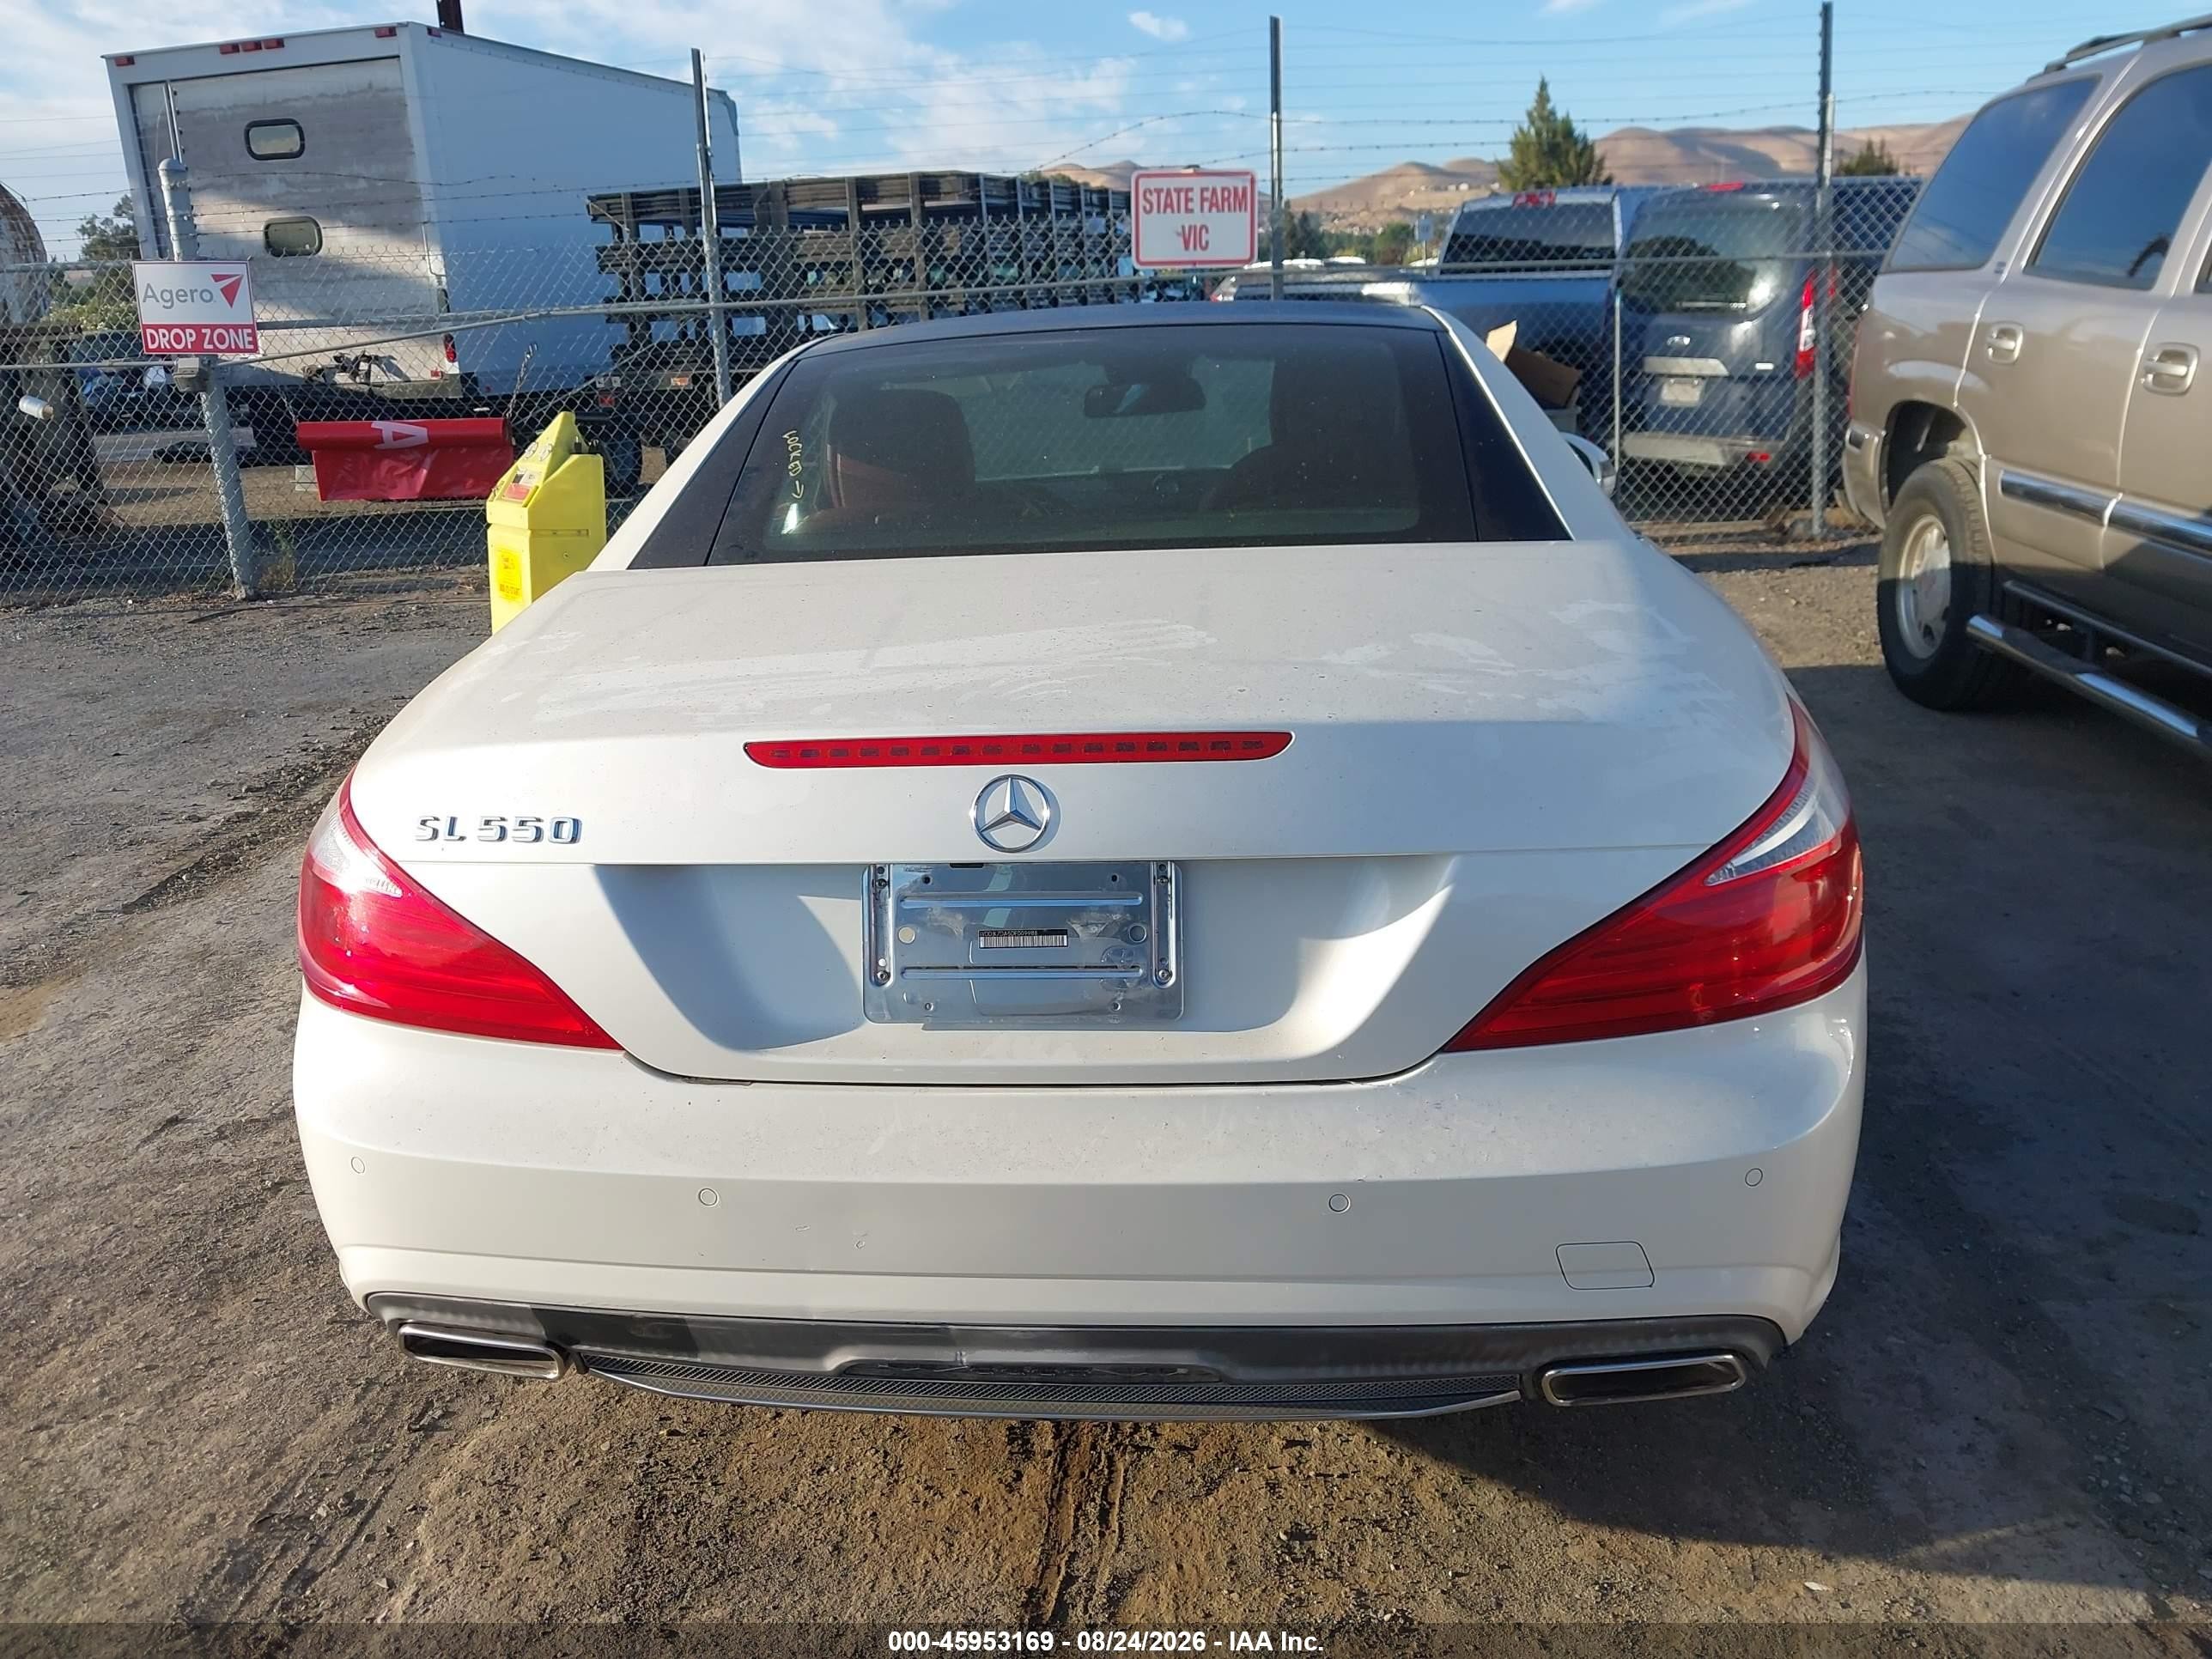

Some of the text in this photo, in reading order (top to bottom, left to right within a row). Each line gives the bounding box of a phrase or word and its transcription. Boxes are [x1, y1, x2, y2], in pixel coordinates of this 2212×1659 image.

[1142, 185, 1249, 215] STATE FARM
[1181, 223, 1210, 252] VIC
[142, 283, 214, 310] Agero
[145, 327, 255, 349] DROP ZONE
[782, 429, 803, 477] LOCKED
[415, 815, 584, 845] SL 550
